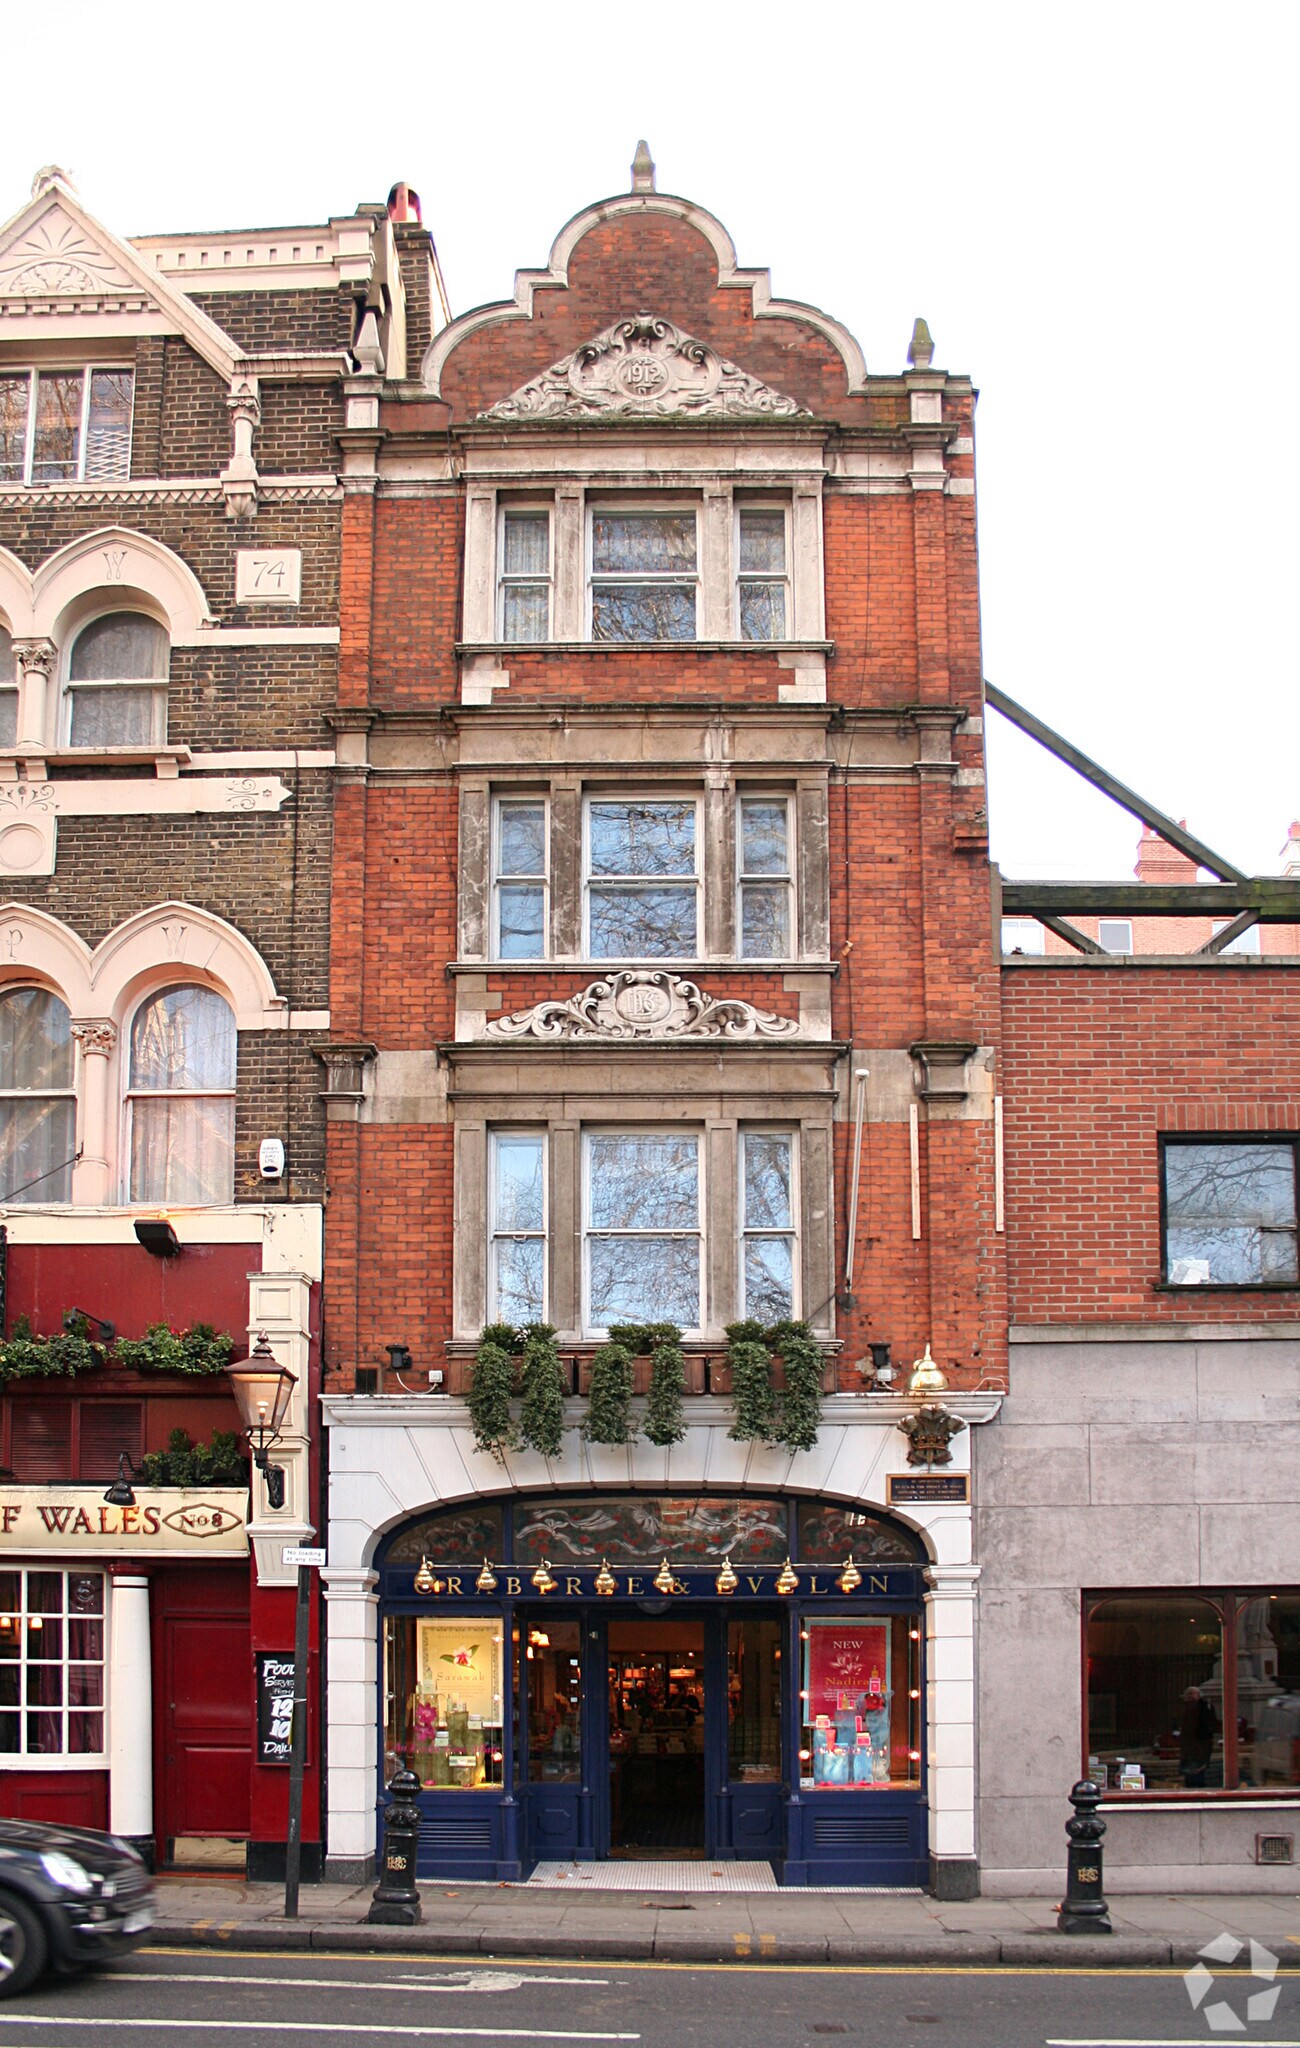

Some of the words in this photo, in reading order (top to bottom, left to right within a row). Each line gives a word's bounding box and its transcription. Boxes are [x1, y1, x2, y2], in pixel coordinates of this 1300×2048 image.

[626, 366, 661, 385] 1912
[252, 560, 286, 588] 74
[37, 1506, 161, 1534] WALES
[833, 1640, 864, 1649] NEW
[436, 1671, 486, 1681] Sarawak
[825, 1676, 869, 1686] Nadira
[270, 1698, 294, 1718] 12
[269, 1718, 291, 1739] 10
